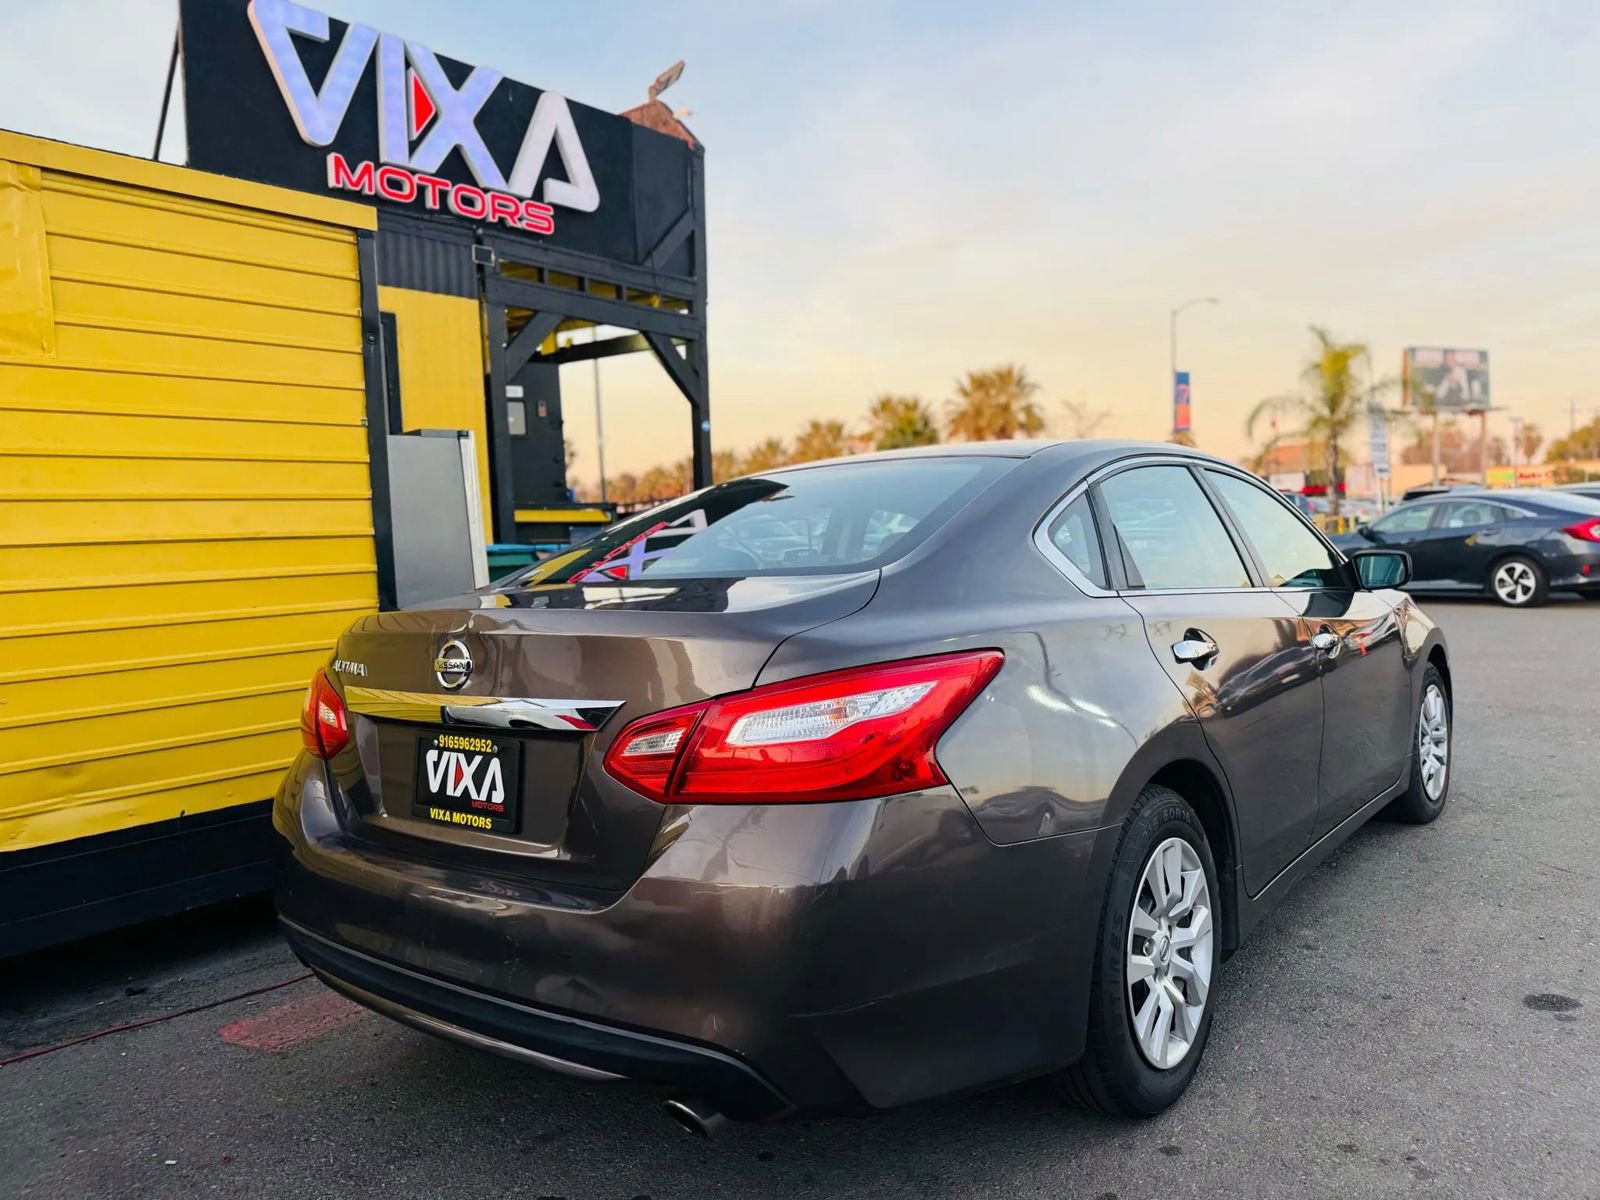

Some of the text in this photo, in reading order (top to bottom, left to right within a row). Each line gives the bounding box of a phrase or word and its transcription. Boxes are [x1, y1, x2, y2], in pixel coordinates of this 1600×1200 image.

[247, 0, 600, 213] VIXA
[327, 152, 555, 235] MOTORS
[436, 660, 469, 671] NISSAN
[438, 734, 492, 753] 9165962952
[426, 749, 505, 804] VIXA
[471, 800, 504, 812] MOTORS
[430, 807, 492, 830] VIXA MOTORS
